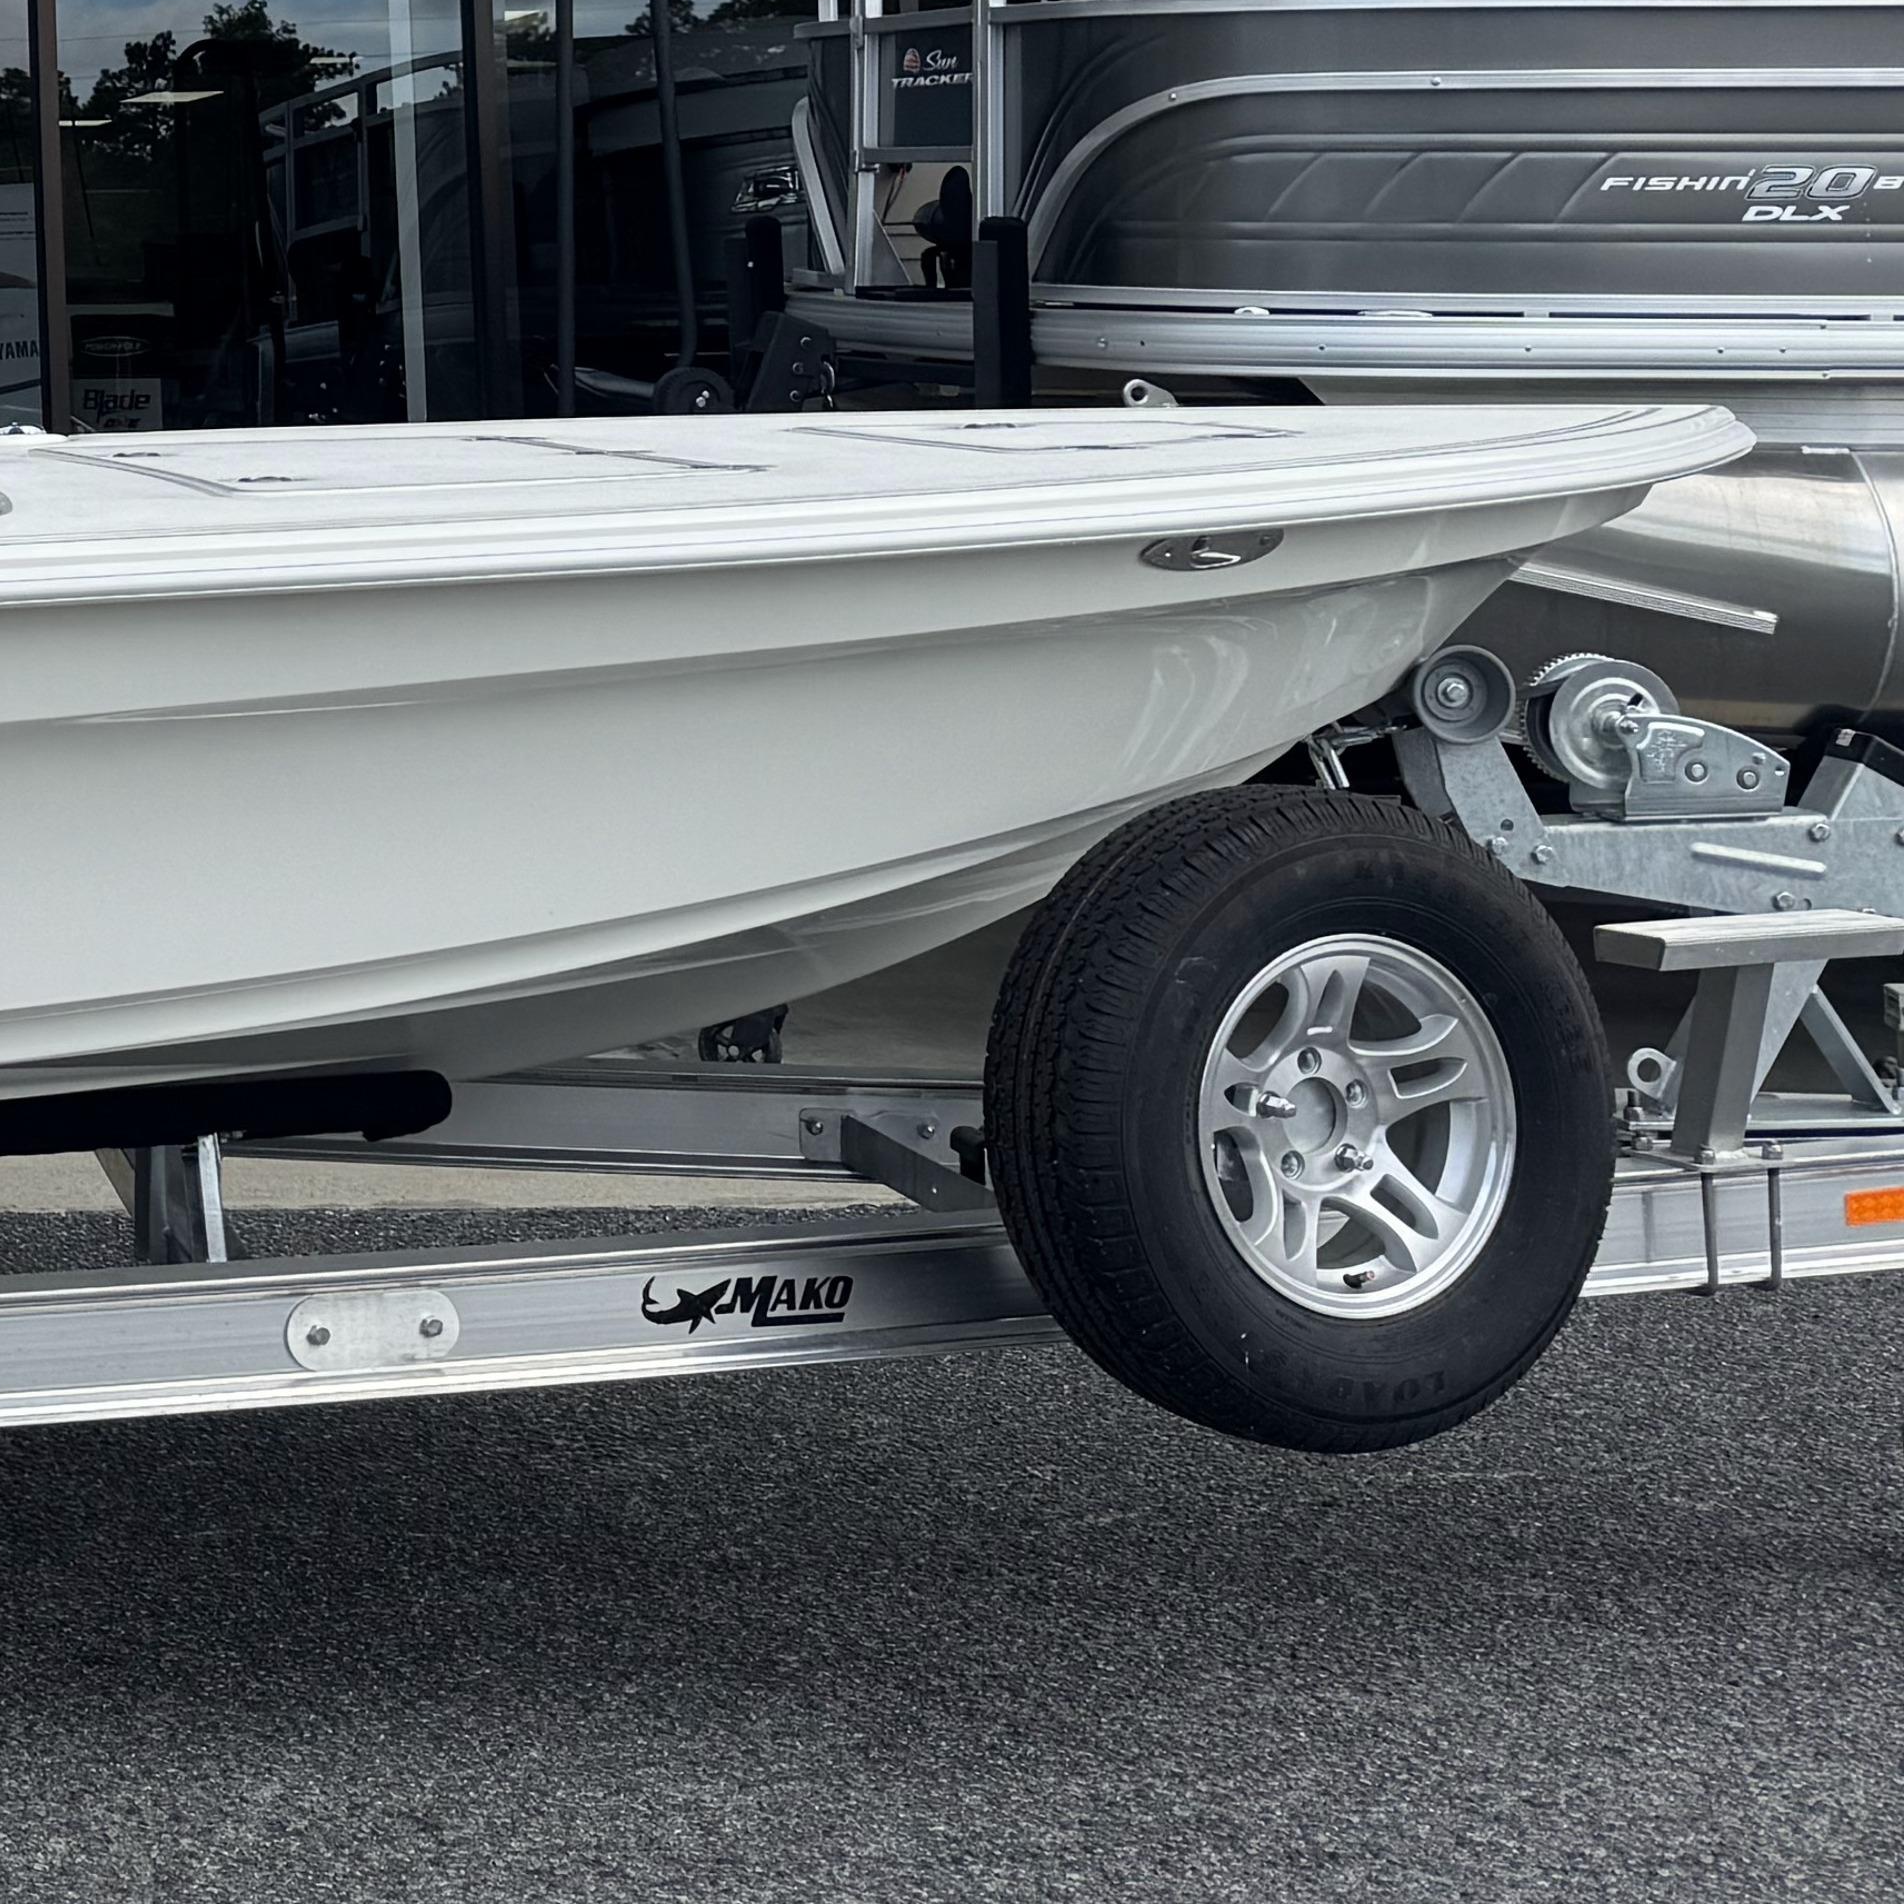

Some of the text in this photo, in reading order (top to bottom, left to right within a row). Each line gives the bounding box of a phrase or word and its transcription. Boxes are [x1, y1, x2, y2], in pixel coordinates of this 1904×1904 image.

[1744, 163, 1880, 201] 20
[1742, 204, 1851, 222] DLX
[84, 389, 151, 421] Blade
[715, 1275, 854, 1327] MAKO
